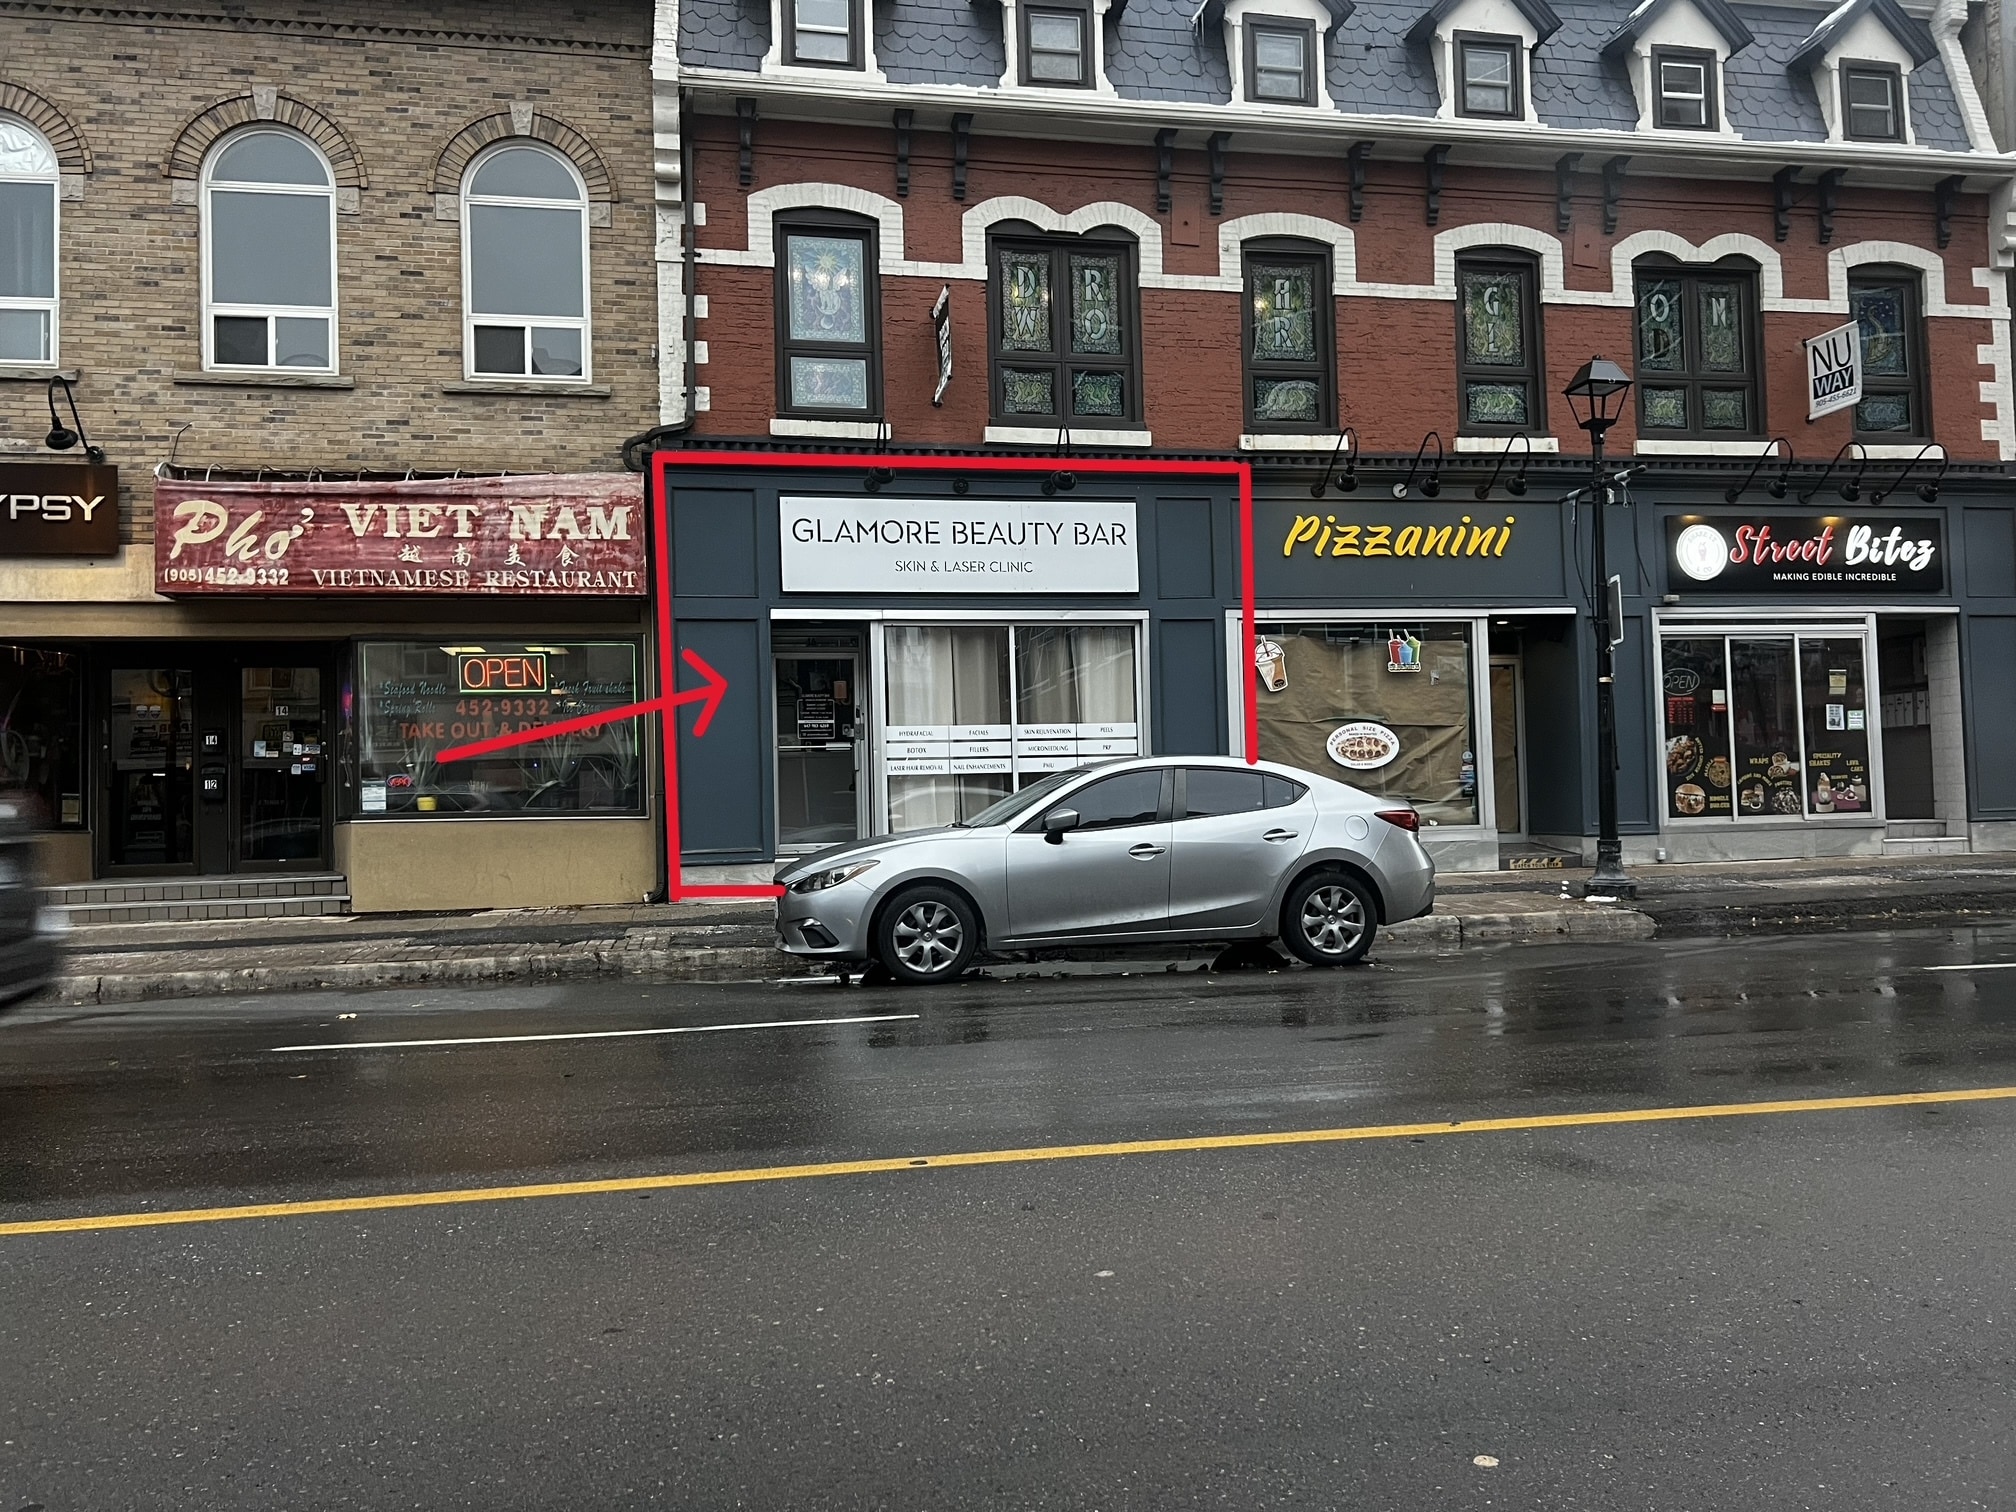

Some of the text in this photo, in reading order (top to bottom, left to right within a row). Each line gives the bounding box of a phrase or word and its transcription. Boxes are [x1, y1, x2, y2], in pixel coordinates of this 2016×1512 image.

[1812, 331, 1852, 377] NU
[1814, 367, 1852, 396] WAY
[0, 495, 105, 522] PSY
[340, 502, 635, 540] VIET NAM
[792, 518, 1127, 546] GLAMORE BEAUTY BAR
[1283, 514, 1516, 557] Pizzanini
[1729, 524, 1936, 572] Street Bitez
[312, 569, 637, 589] VIETNAMESE RESTAURANT
[894, 560, 1033, 574] SKIN & LASER CLINIC
[1773, 572, 1897, 582] MAKING EDIBLE INCREDIBLE
[464, 657, 542, 688] OPEN
[1664, 675, 1696, 689] OPEN
[456, 699, 549, 717] 452-9332
[400, 722, 445, 739] TAKE
[450, 722, 493, 739] OUT
[1329, 726, 1358, 746] PERSONAL
[1380, 730, 1396, 746] PIZZA
